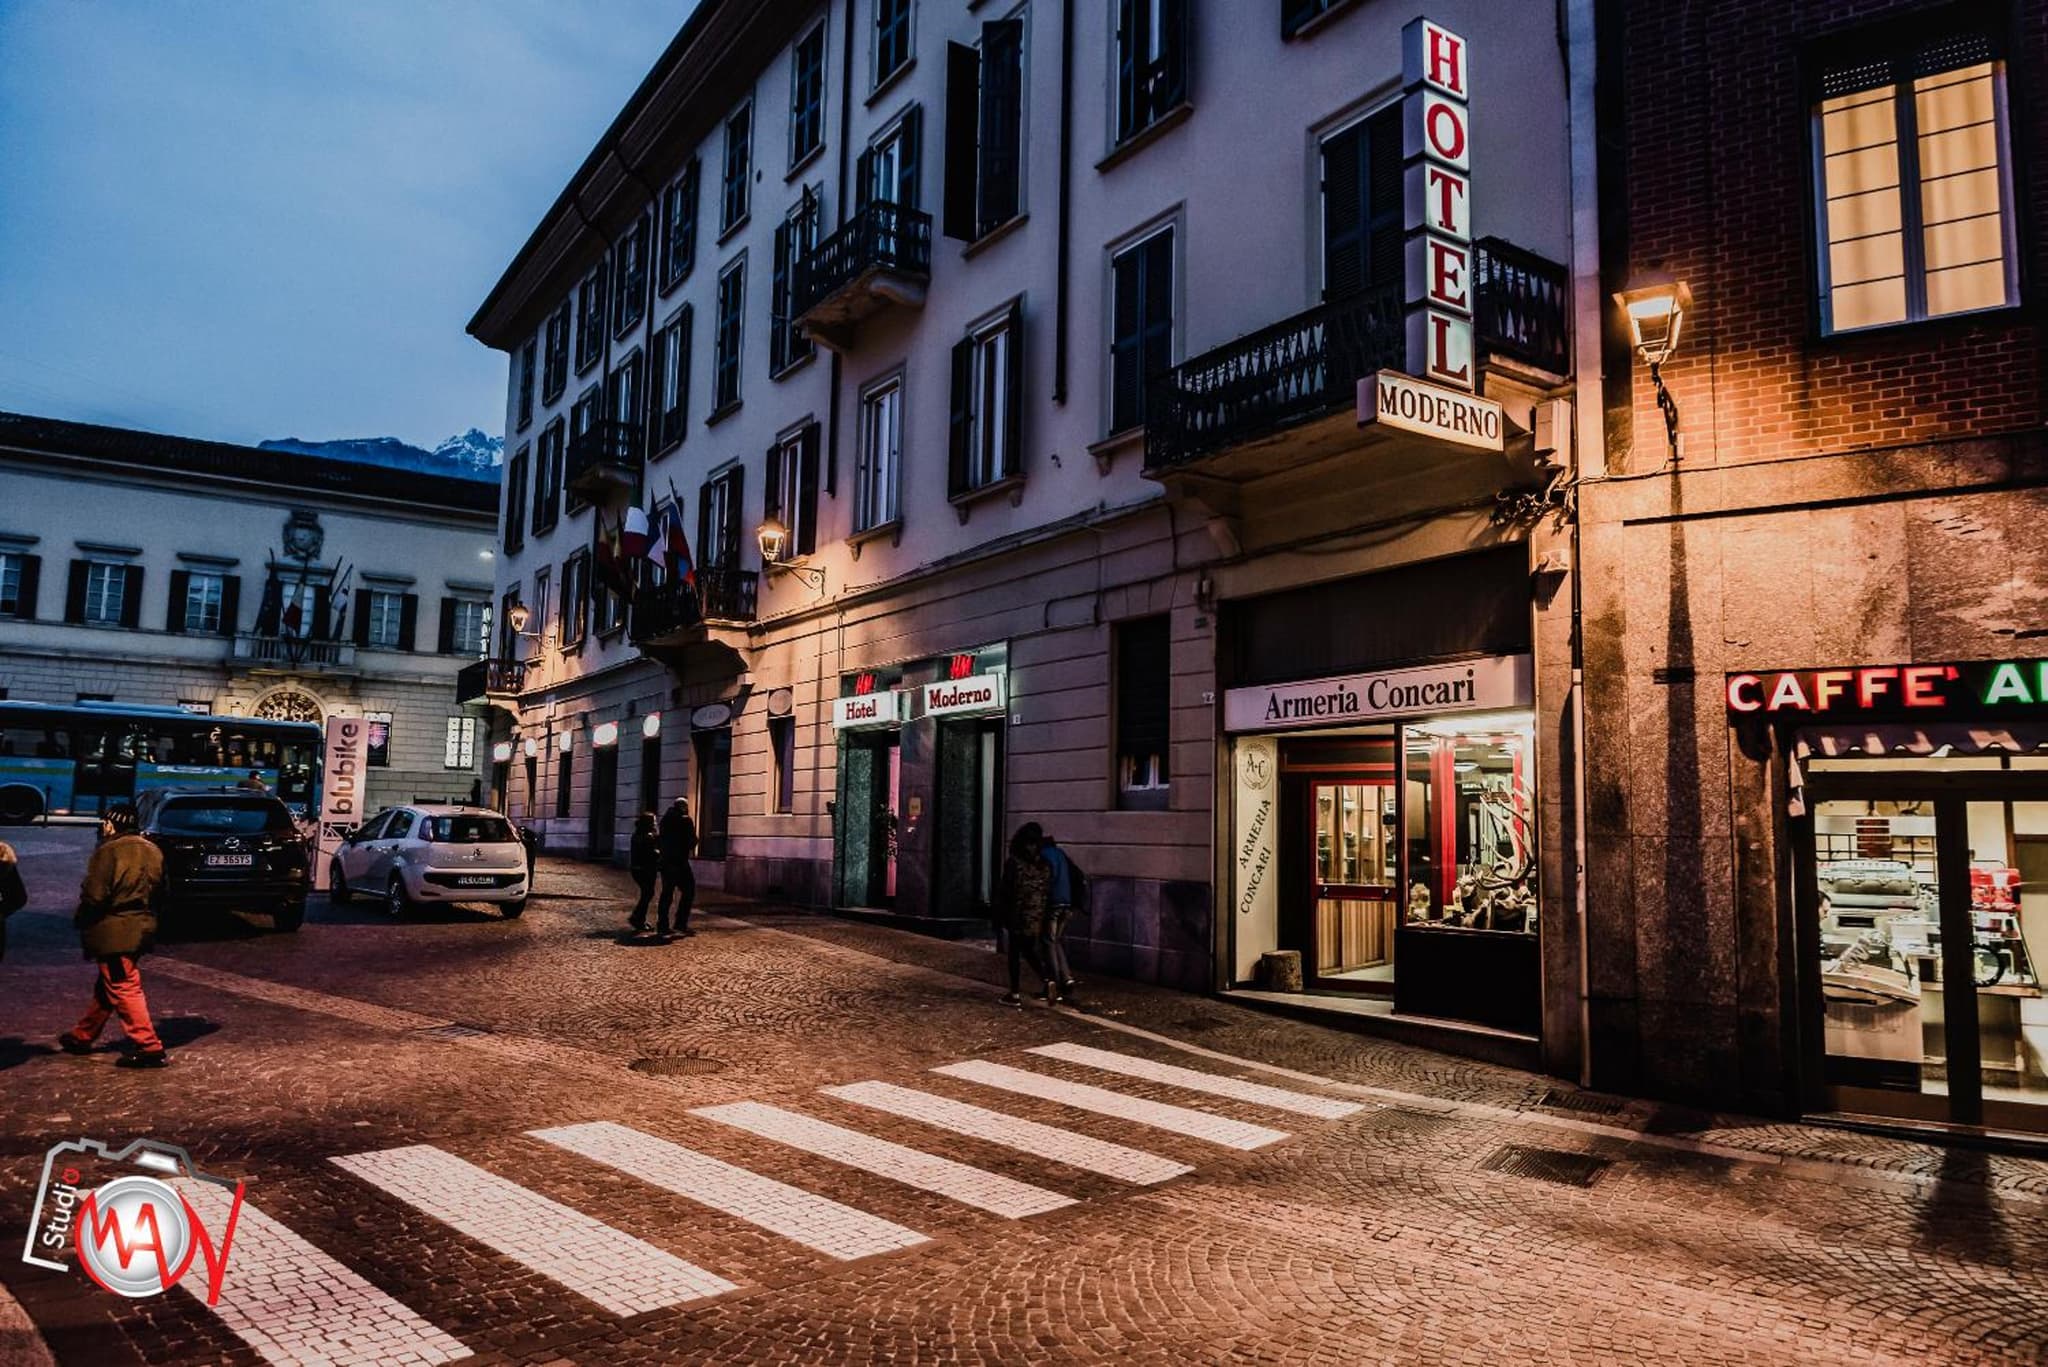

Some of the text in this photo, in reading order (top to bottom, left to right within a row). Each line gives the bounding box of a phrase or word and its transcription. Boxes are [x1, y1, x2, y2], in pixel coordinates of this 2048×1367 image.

[1426, 27, 1468, 382] HOTEL
[1379, 382, 1499, 440] MODERNO
[845, 685, 992, 721] Hotel Moderno
[1264, 668, 1476, 721] Armeria Concari
[1727, 664, 1960, 712] CAFFE'
[328, 722, 360, 815] blubike
[1239, 799, 1272, 870] ARMERIA
[1240, 846, 1272, 914] CONCARI
